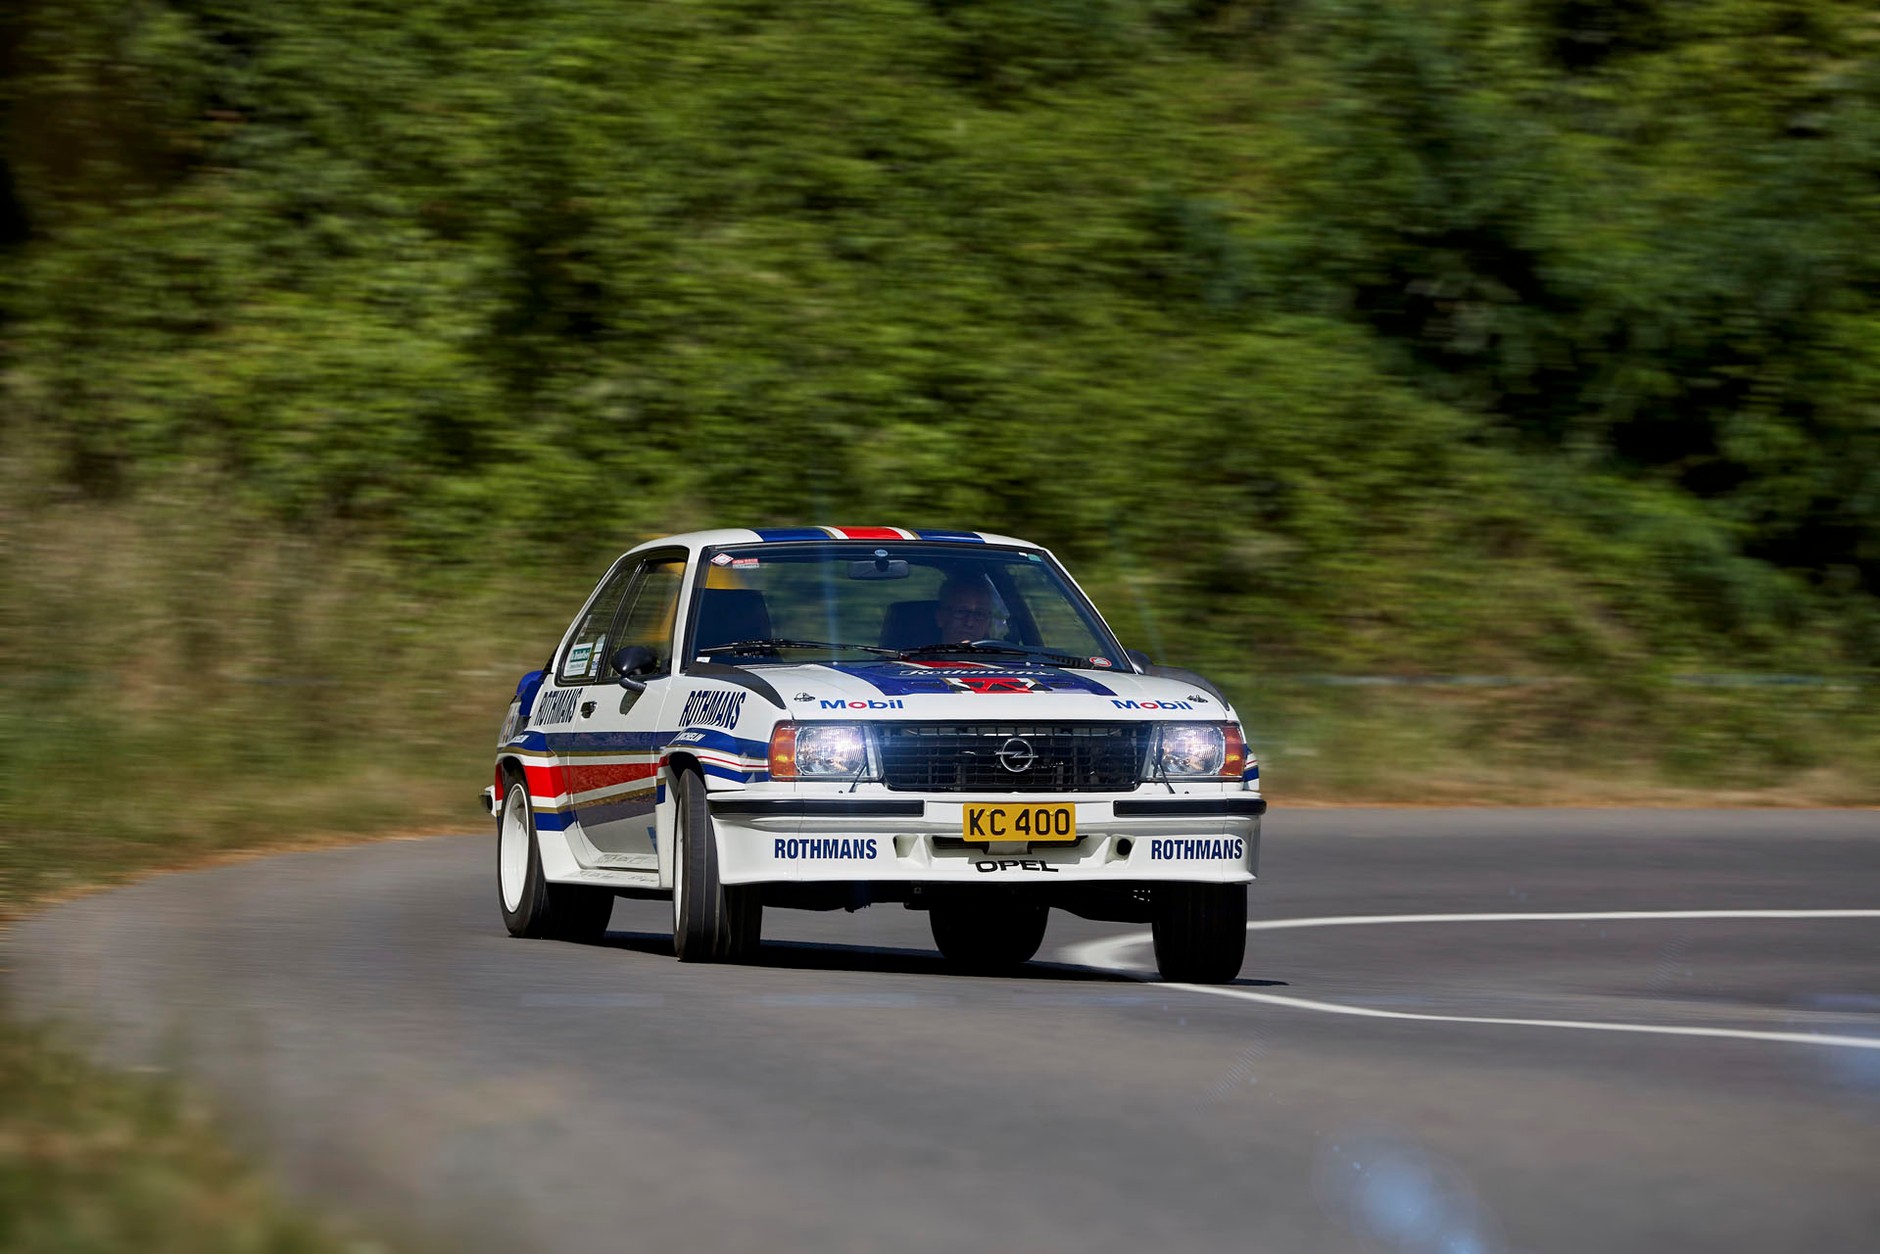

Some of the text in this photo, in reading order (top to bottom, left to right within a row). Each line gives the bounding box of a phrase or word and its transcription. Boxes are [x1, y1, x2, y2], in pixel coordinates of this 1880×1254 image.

[679, 690, 746, 730] ROTHMANS
[820, 700, 904, 709] Mobil
[1111, 700, 1193, 710] Mobil
[969, 809, 1070, 836] KC 400
[774, 839, 877, 859] ROTHMANS
[1151, 839, 1243, 859] ROTHMANS
[975, 860, 1059, 873] OPEL
